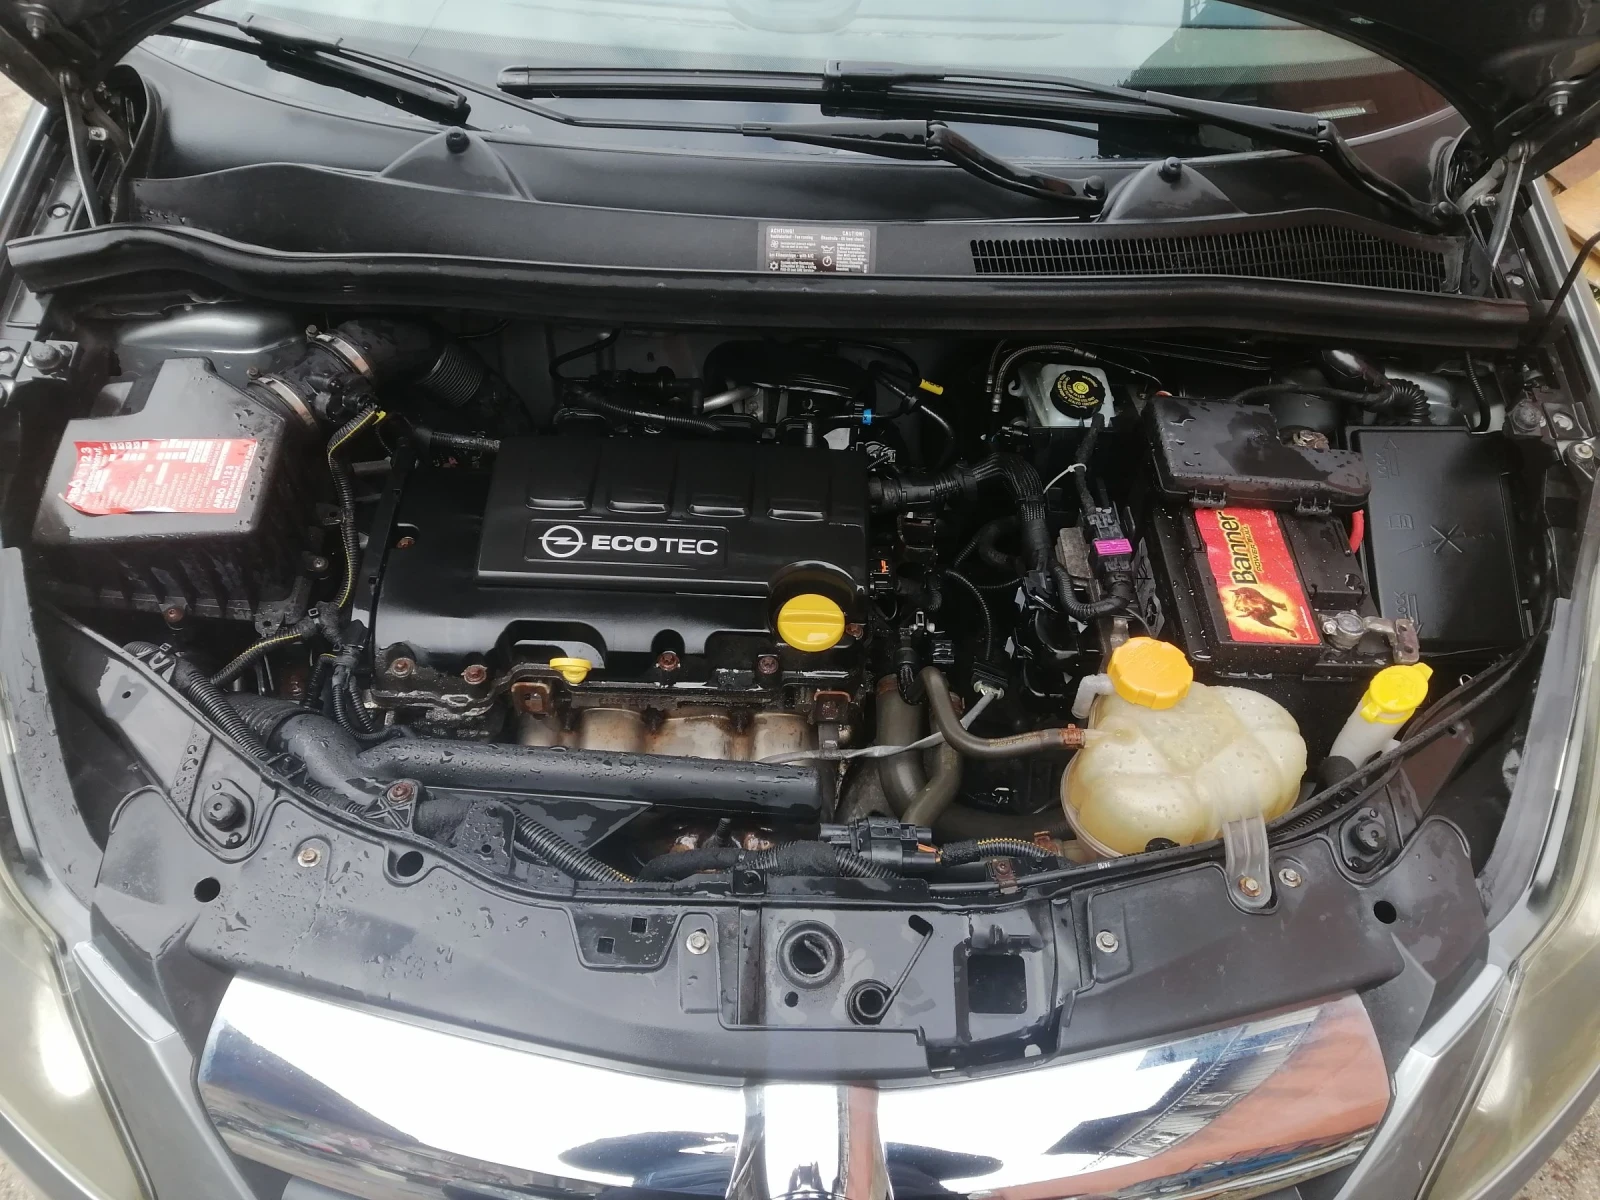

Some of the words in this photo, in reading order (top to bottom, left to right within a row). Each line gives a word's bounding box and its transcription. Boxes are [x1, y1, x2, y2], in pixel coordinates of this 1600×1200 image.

[213, 487, 226, 508] ARBÖ
[591, 534, 719, 555] ECOTEC
[1217, 511, 1258, 584] Banner
[1251, 545, 1263, 572] POWER
